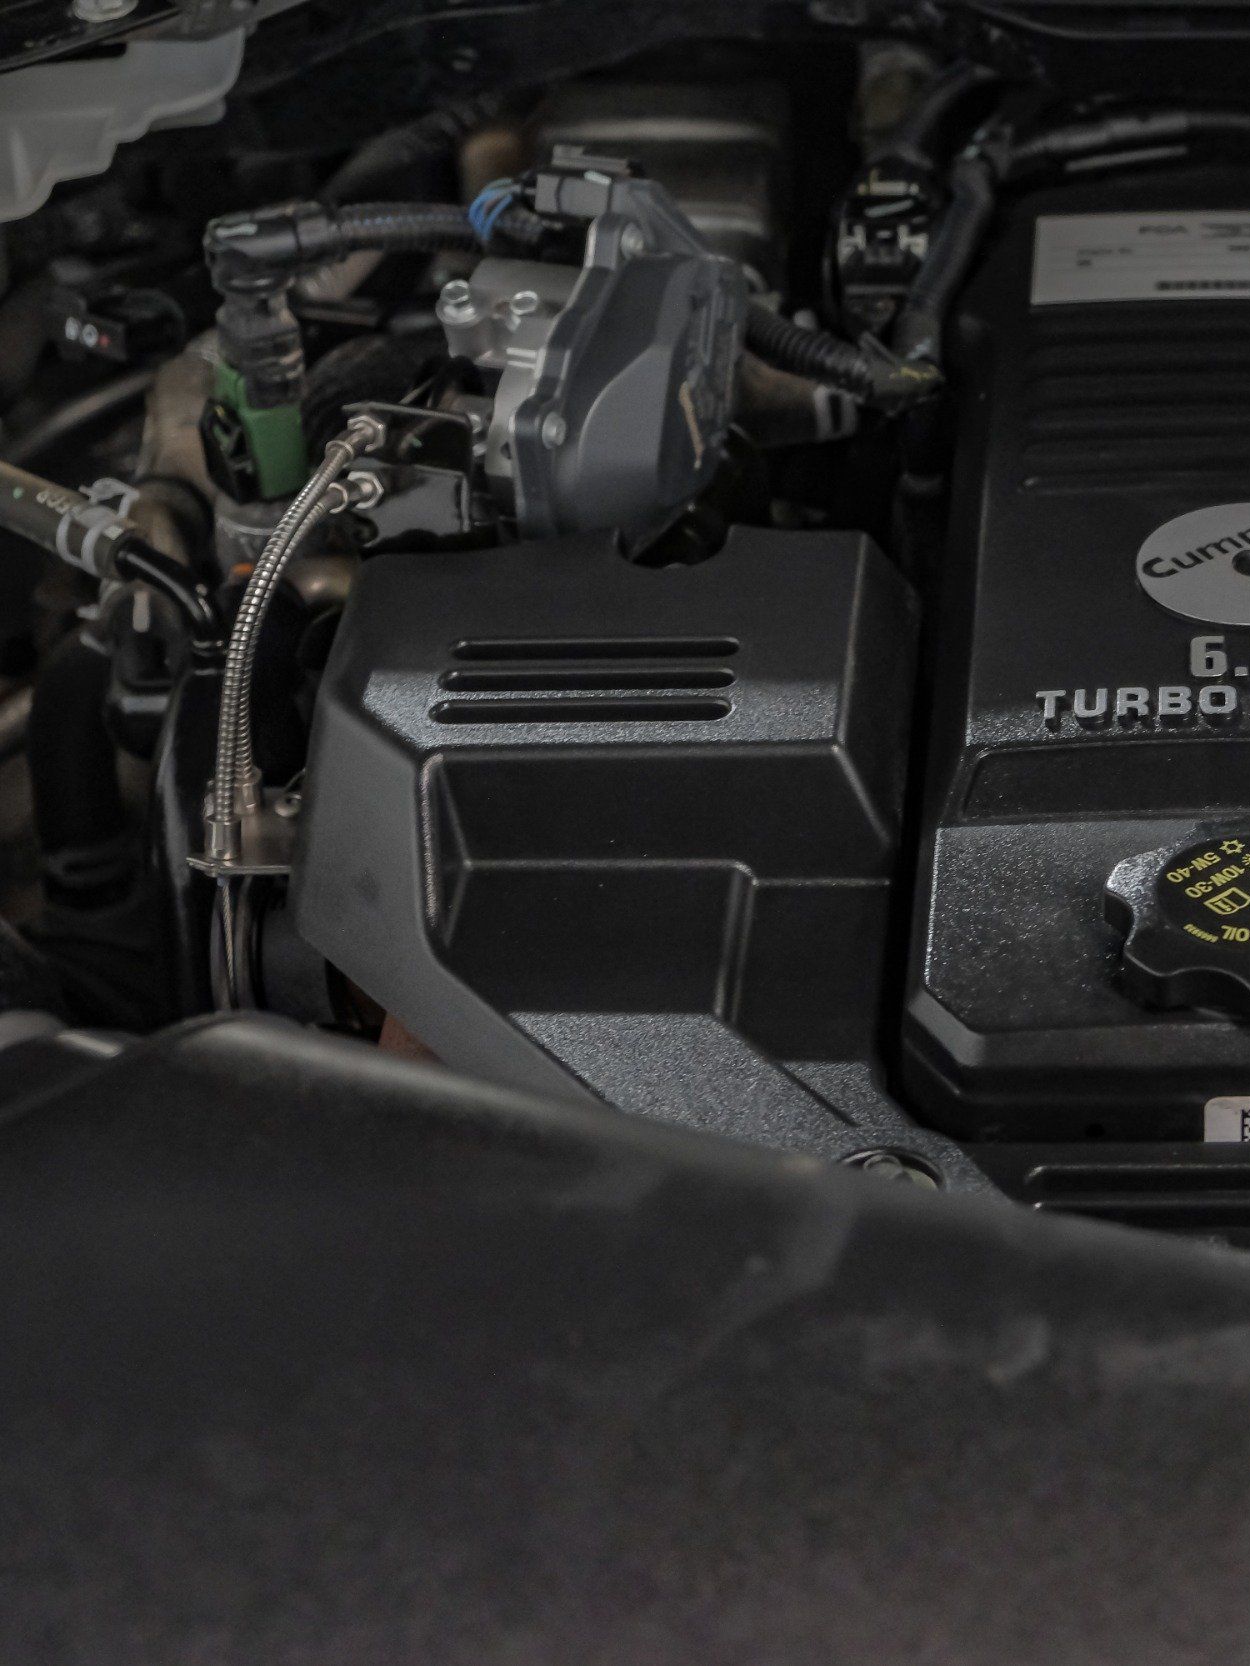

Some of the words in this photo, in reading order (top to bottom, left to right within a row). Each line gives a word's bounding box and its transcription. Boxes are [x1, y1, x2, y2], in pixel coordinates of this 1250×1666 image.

[1035, 684, 1239, 721] TURBO
[1166, 851, 1222, 884] 5W-40
[1184, 864, 1246, 899] 10W-30
[1220, 924, 1250, 943] OIL
